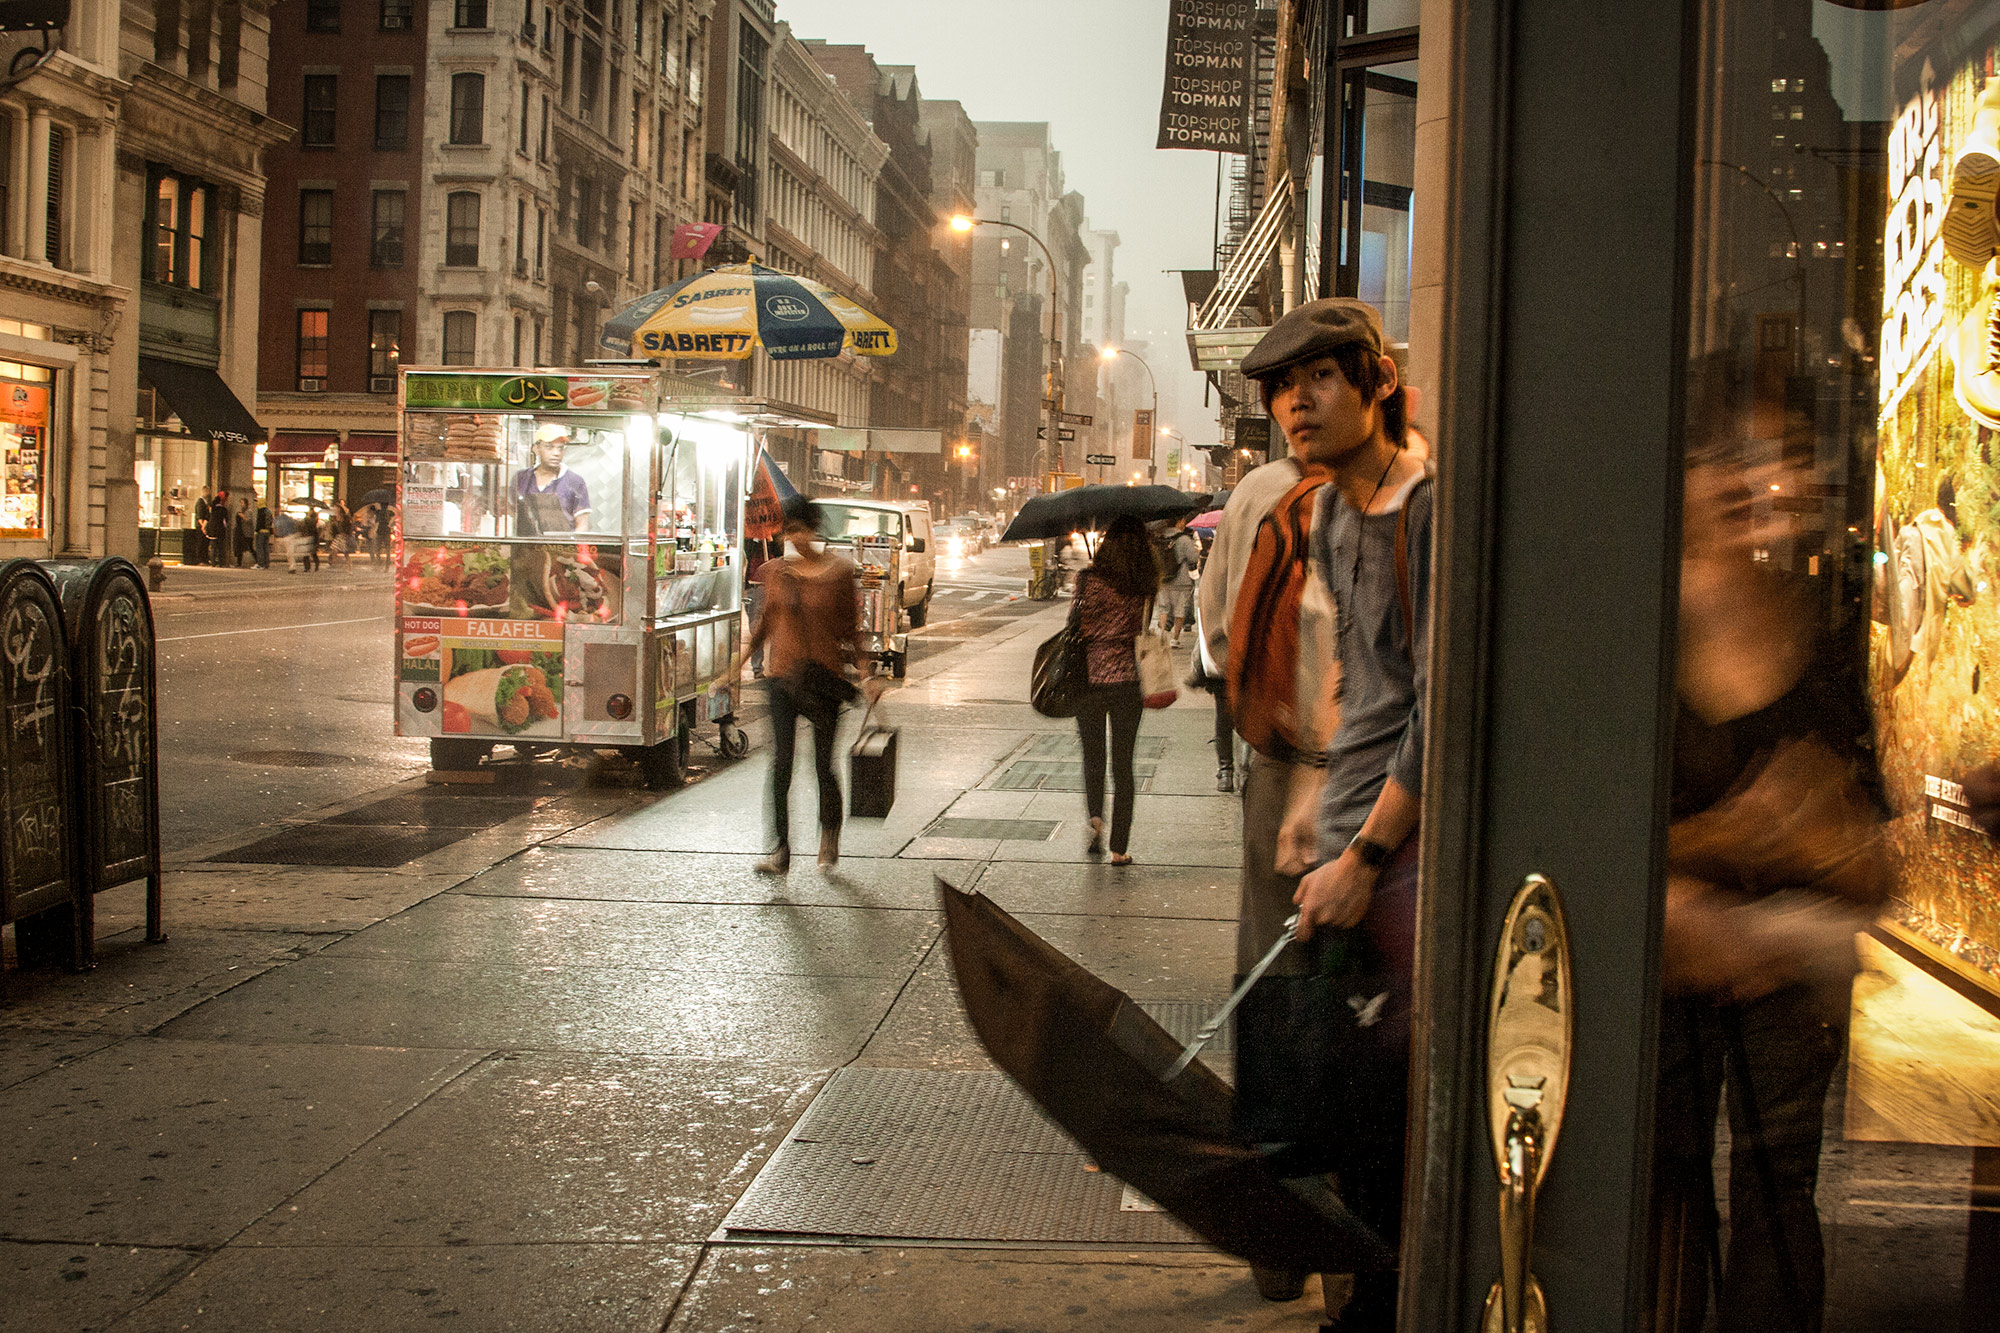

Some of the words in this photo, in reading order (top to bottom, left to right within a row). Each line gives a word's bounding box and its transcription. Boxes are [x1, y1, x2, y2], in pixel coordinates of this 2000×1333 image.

[1179, 0, 1248, 17] TOPSHOP
[1177, 13, 1246, 30] TOPMAN
[1174, 38, 1243, 55] TOPSHOP
[1174, 52, 1243, 69] TOPMAN
[1172, 76, 1241, 93] TOPSHOP
[1171, 91, 1241, 108] TOPMAN
[1168, 112, 1240, 130] TOPSHOP
[1166, 127, 1240, 144] TOPMAN
[673, 288, 752, 309] SABRETT
[643, 332, 752, 353] SABRETT
[807, 342, 826, 351] ROLL
[508, 378, 565, 406] حلال
[404, 621, 421, 629] HOT
[422, 621, 440, 630] DOG
[467, 621, 545, 638] FALAFEL
[403, 658, 438, 670] HALAL
